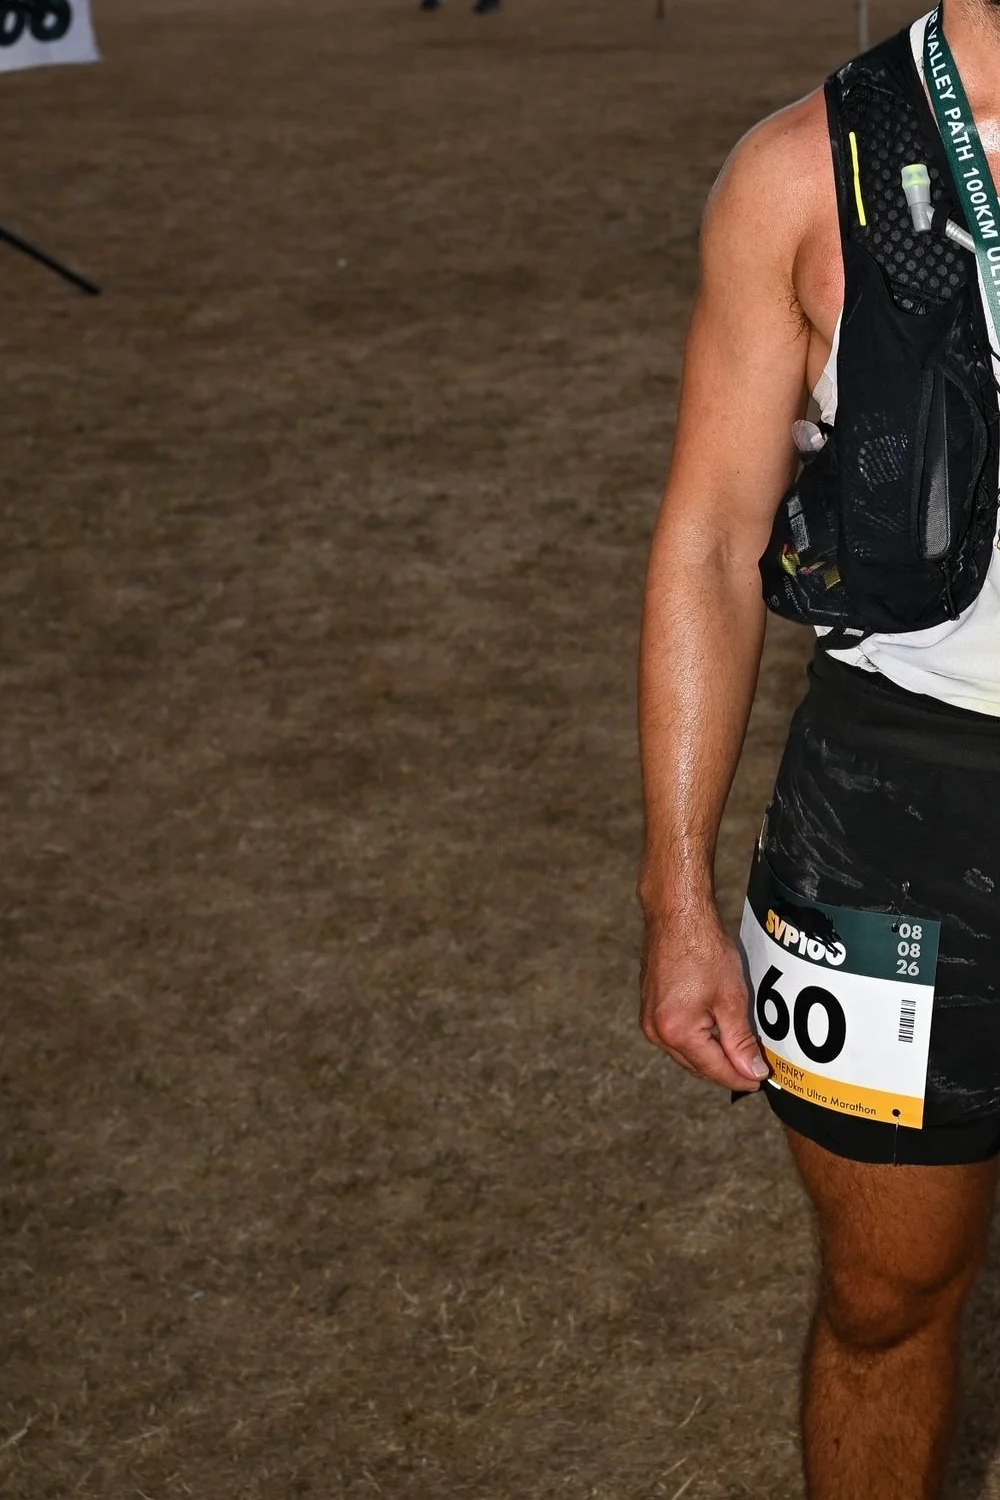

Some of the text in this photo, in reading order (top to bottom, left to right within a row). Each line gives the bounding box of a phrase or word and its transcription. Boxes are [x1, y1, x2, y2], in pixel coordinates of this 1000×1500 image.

[926, 28, 956, 101] VALLEY
[944, 106, 975, 162] PATH
[963, 167, 999, 240] 100KM
[765, 908, 847, 967] SVP100
[898, 923, 923, 940] 08
[897, 941, 921, 959] 08
[895, 959, 920, 976] 26
[756, 964, 847, 1064] 60
[775, 1058, 805, 1081] HENRY
[779, 1074, 804, 1094] 100km
[806, 1087, 828, 1103] Ultra
[829, 1096, 877, 1116] Marathon
